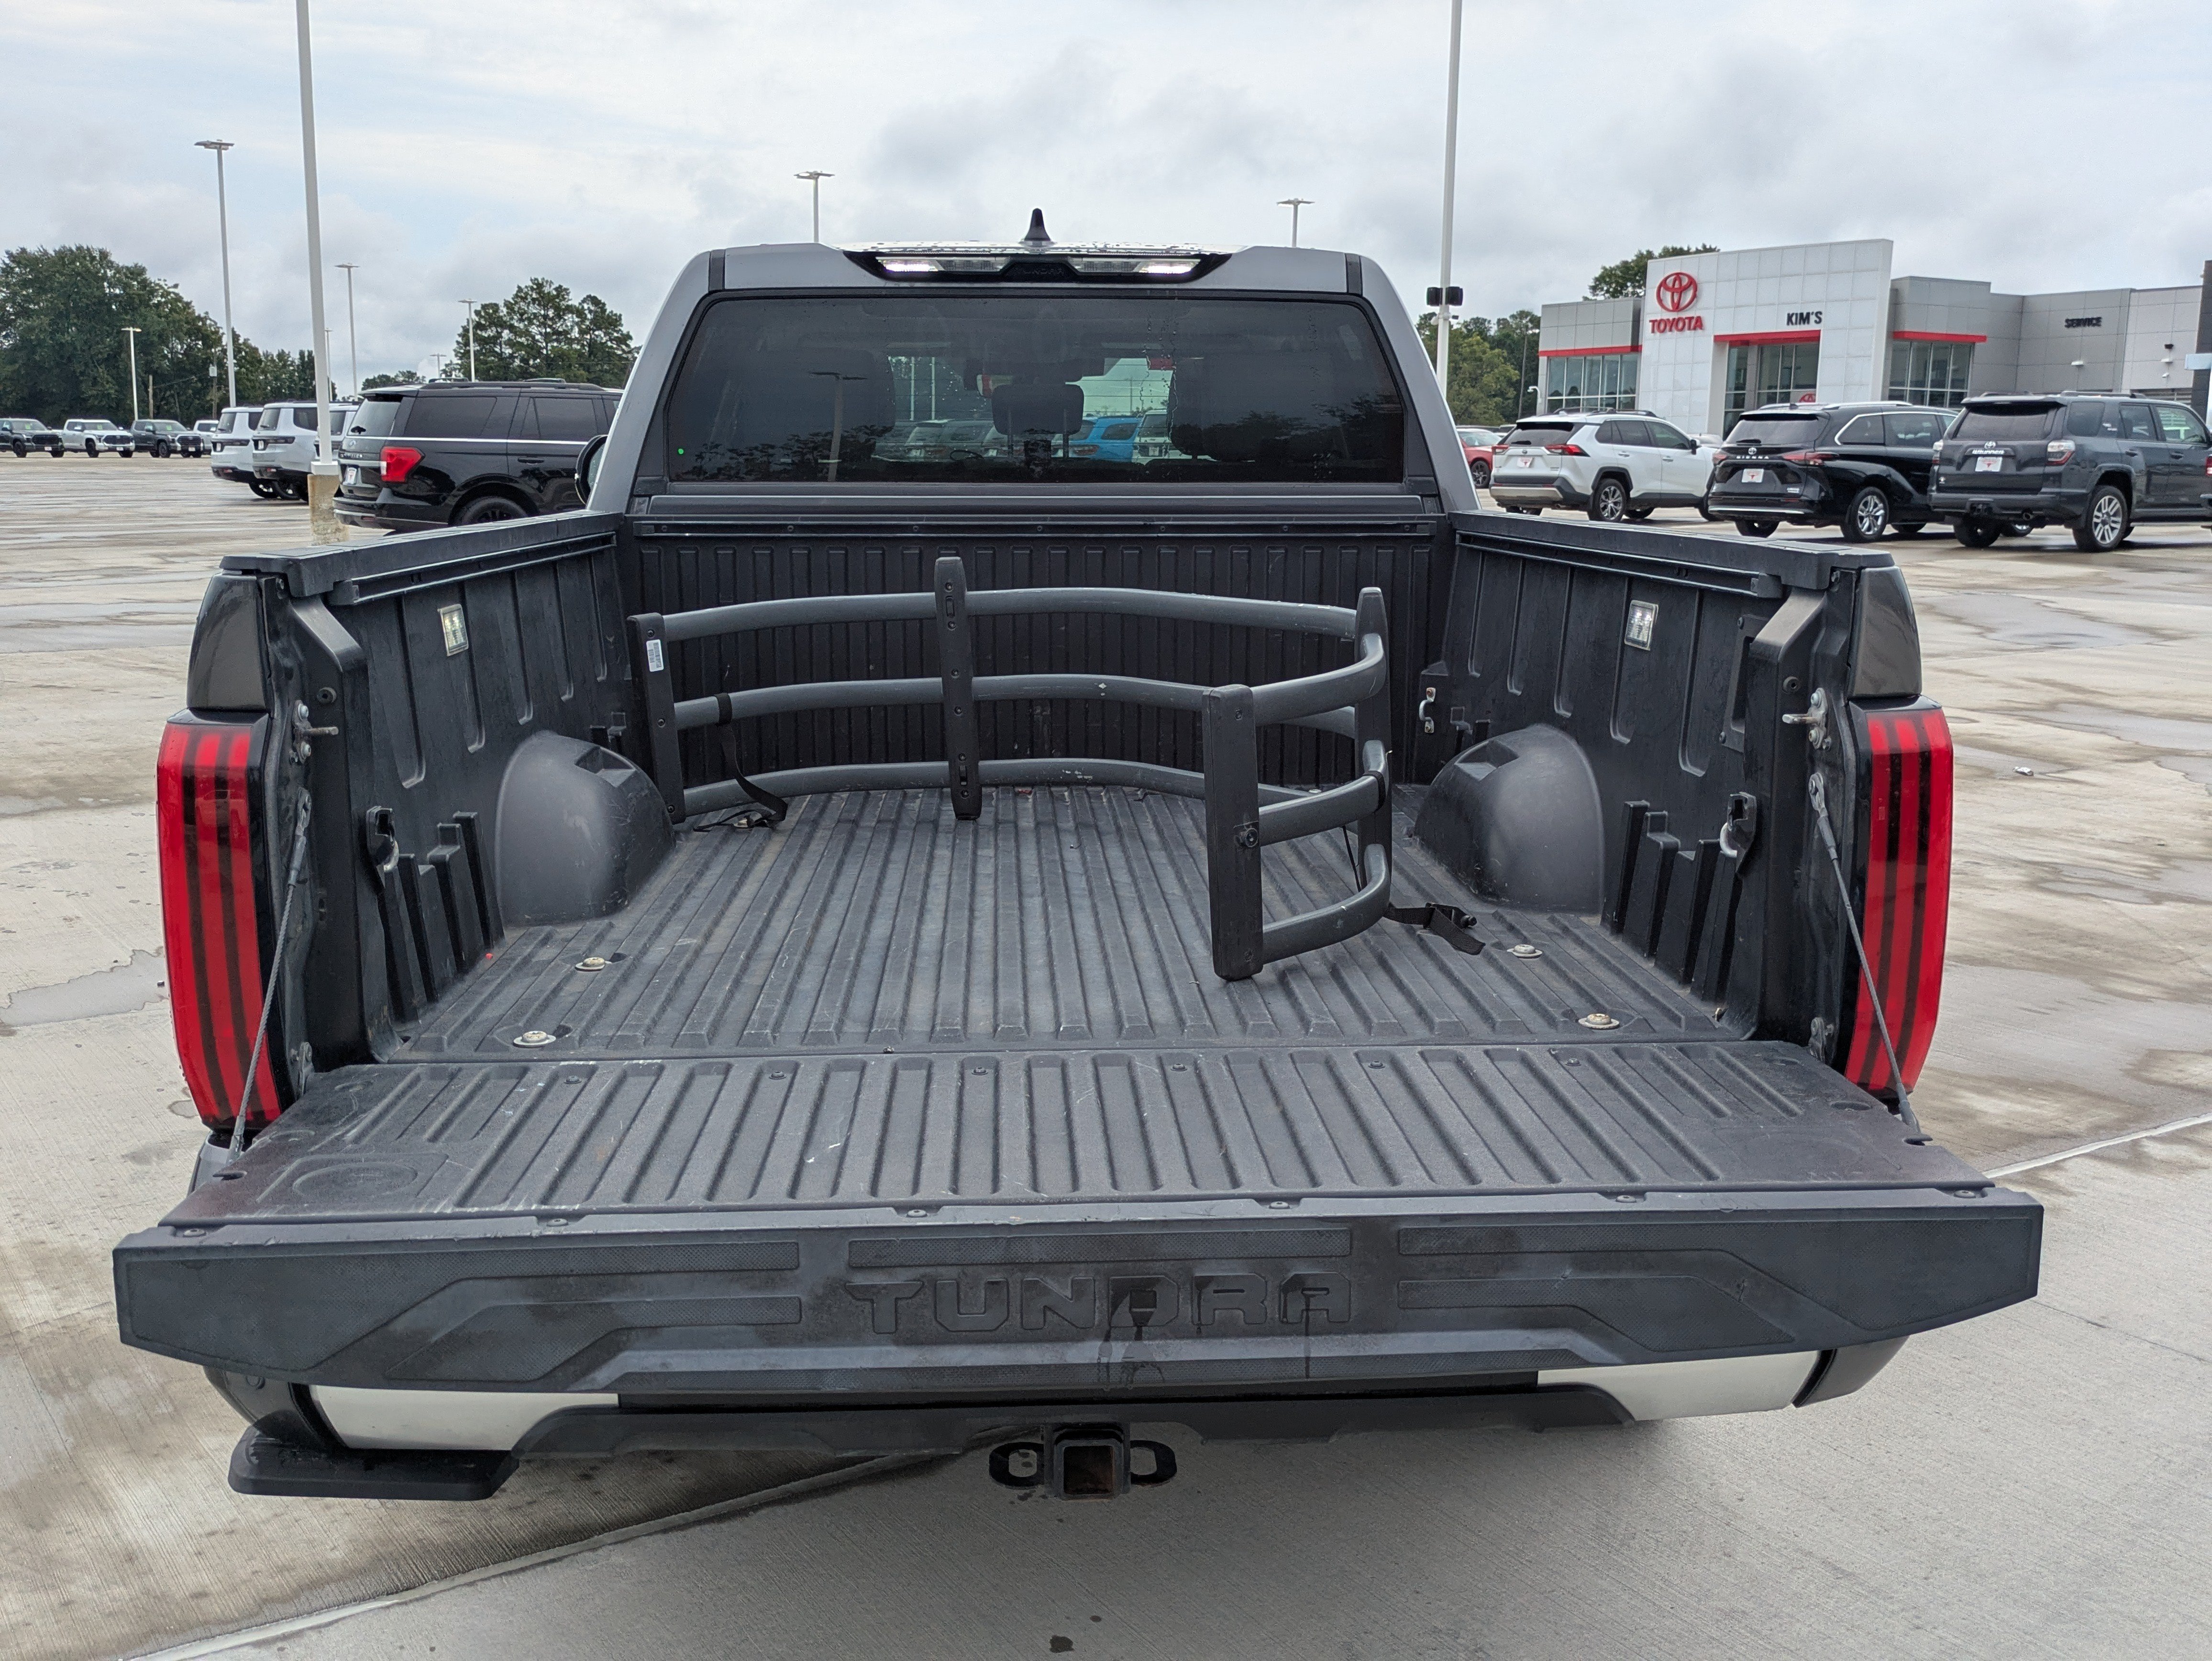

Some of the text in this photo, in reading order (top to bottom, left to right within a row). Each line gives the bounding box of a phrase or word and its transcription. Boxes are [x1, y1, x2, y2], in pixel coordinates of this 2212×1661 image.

[1649, 316, 1703, 334] TOYOTA
[1786, 311, 1823, 326] KIM'S
[2064, 317, 2102, 329] SERVICE
[844, 1272, 1351, 1334] TUNDRA
